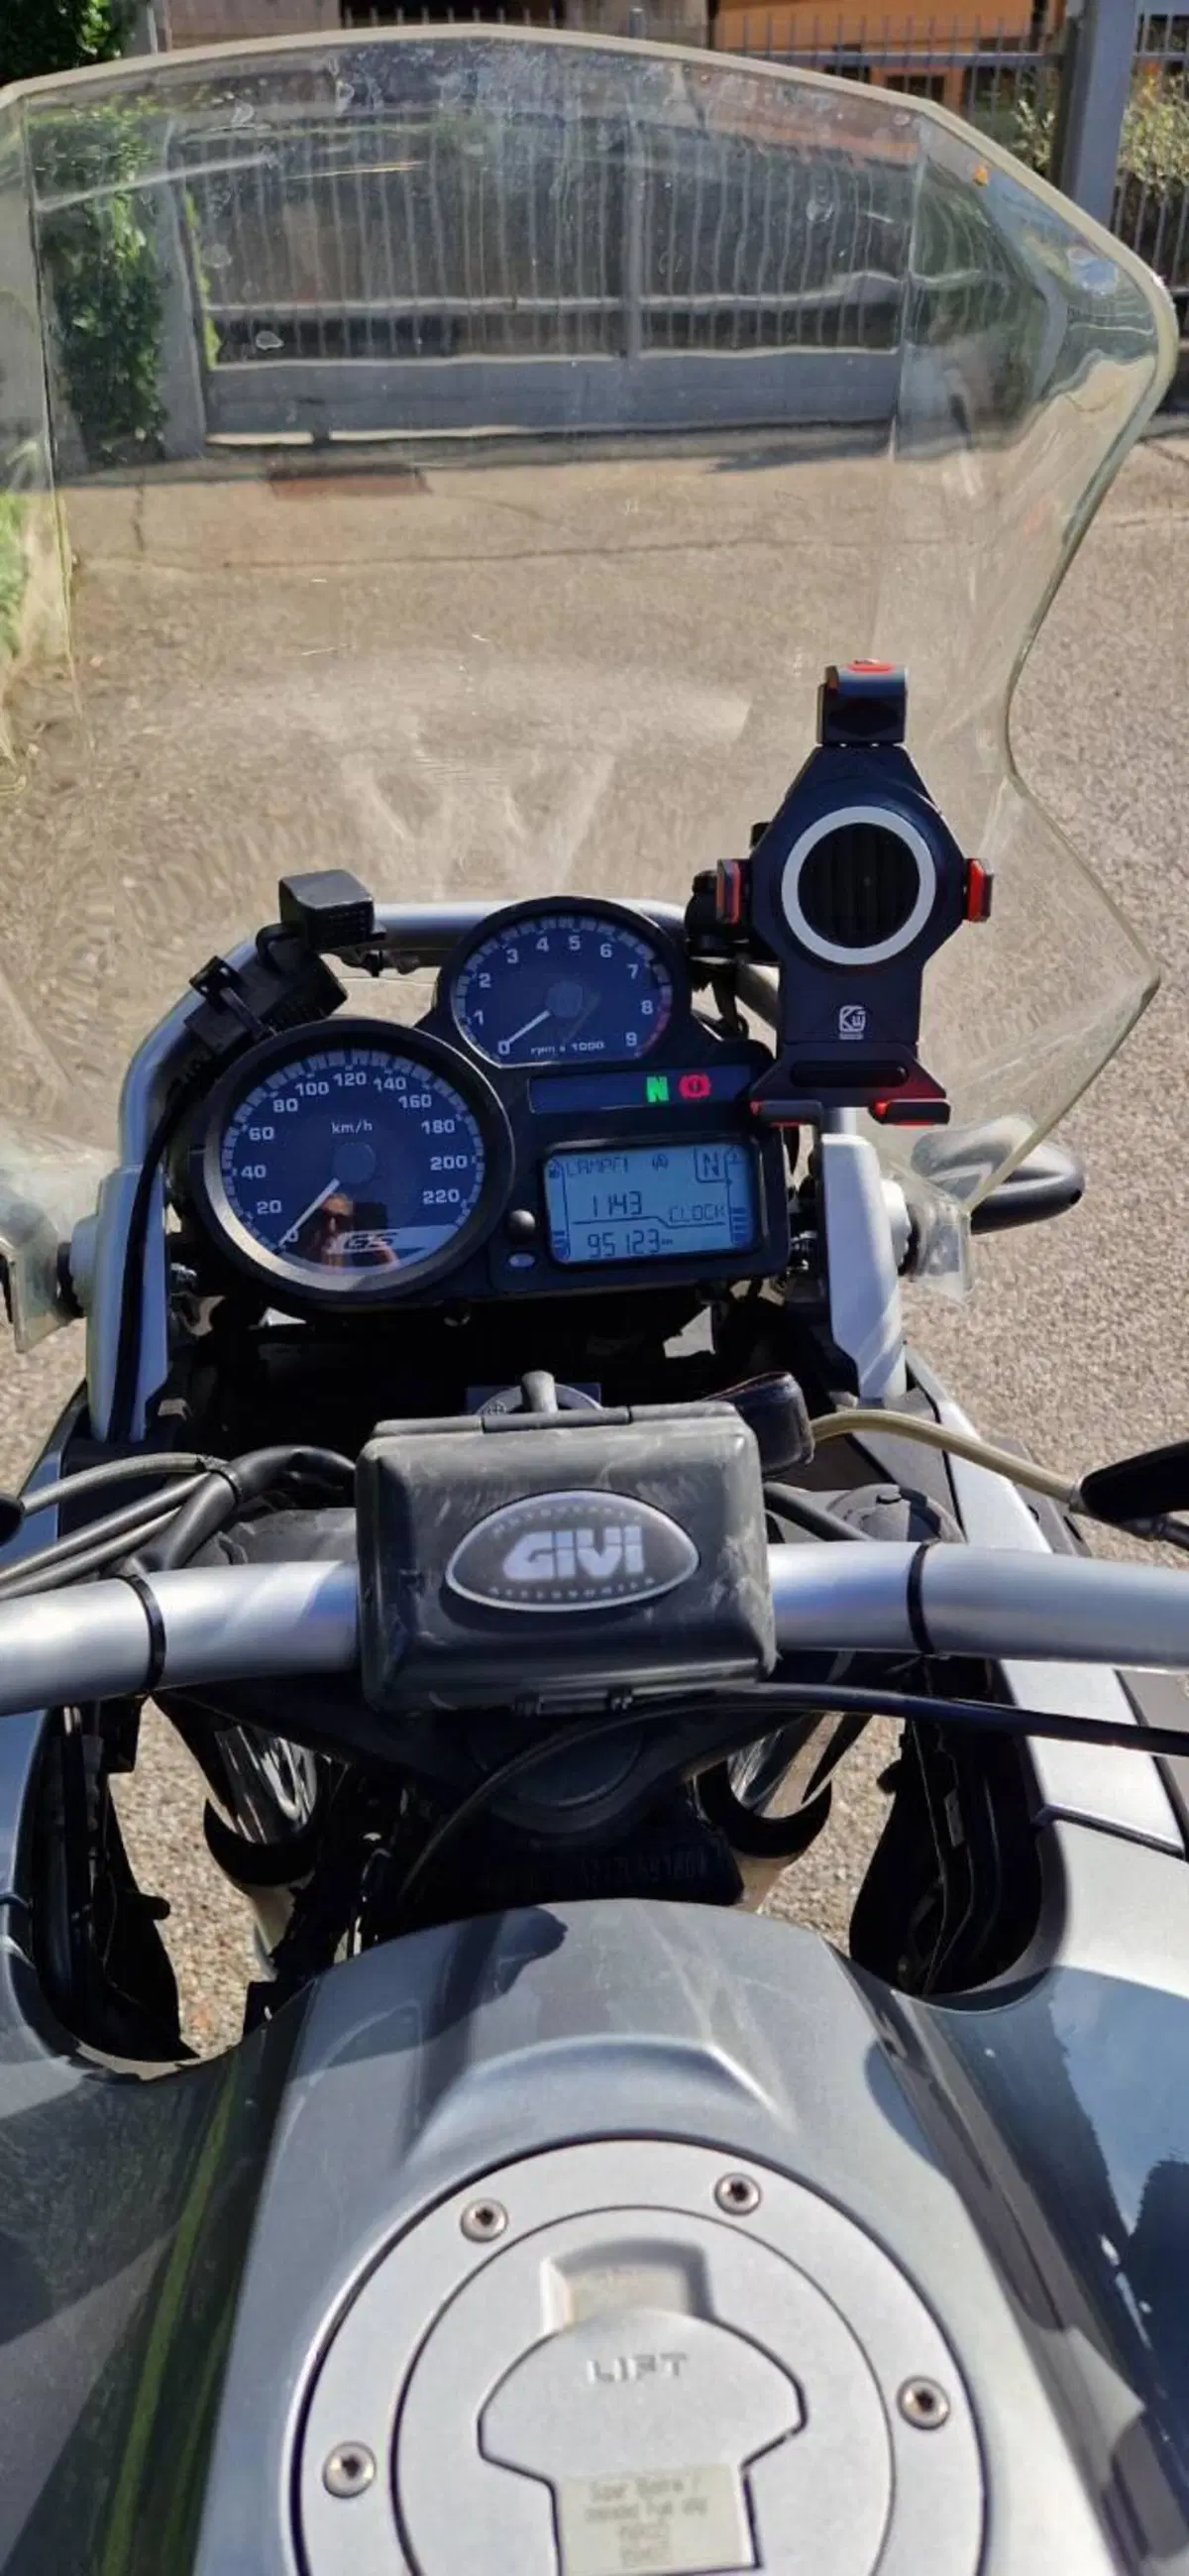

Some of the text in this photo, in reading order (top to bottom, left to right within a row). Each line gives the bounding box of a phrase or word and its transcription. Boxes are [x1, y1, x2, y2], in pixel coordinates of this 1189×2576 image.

[536, 937, 549, 952] 4
[568, 936, 581, 951] 5
[600, 944, 612, 958] 6
[506, 949, 519, 964] 3
[627, 963, 639, 979] 7
[479, 972, 491, 989] 2
[641, 1000, 653, 1016] 8
[474, 1010, 485, 1026] 1
[571, 1041, 605, 1053] 1000
[626, 1032, 637, 1047] 9
[497, 1041, 510, 1056] 0
[334, 1072, 367, 1087] 120
[373, 1076, 407, 1092] 140
[294, 1081, 330, 1096] 100
[646, 1076, 670, 1103] N
[272, 1098, 298, 1113] 80
[398, 1093, 433, 1109] 160
[249, 1126, 274, 1141] 60
[331, 1121, 374, 1135] km/h
[421, 1118, 456, 1134] 180
[429, 1156, 469, 1172] 200
[703, 1152, 719, 1177] N
[241, 1165, 267, 1179] 40
[422, 1188, 461, 1204] 220
[256, 1199, 282, 1214] 20
[668, 1202, 726, 1224] CLOCK
[501, 1525, 644, 1580] GIVI
[587, 2352, 688, 2383] LIFT
